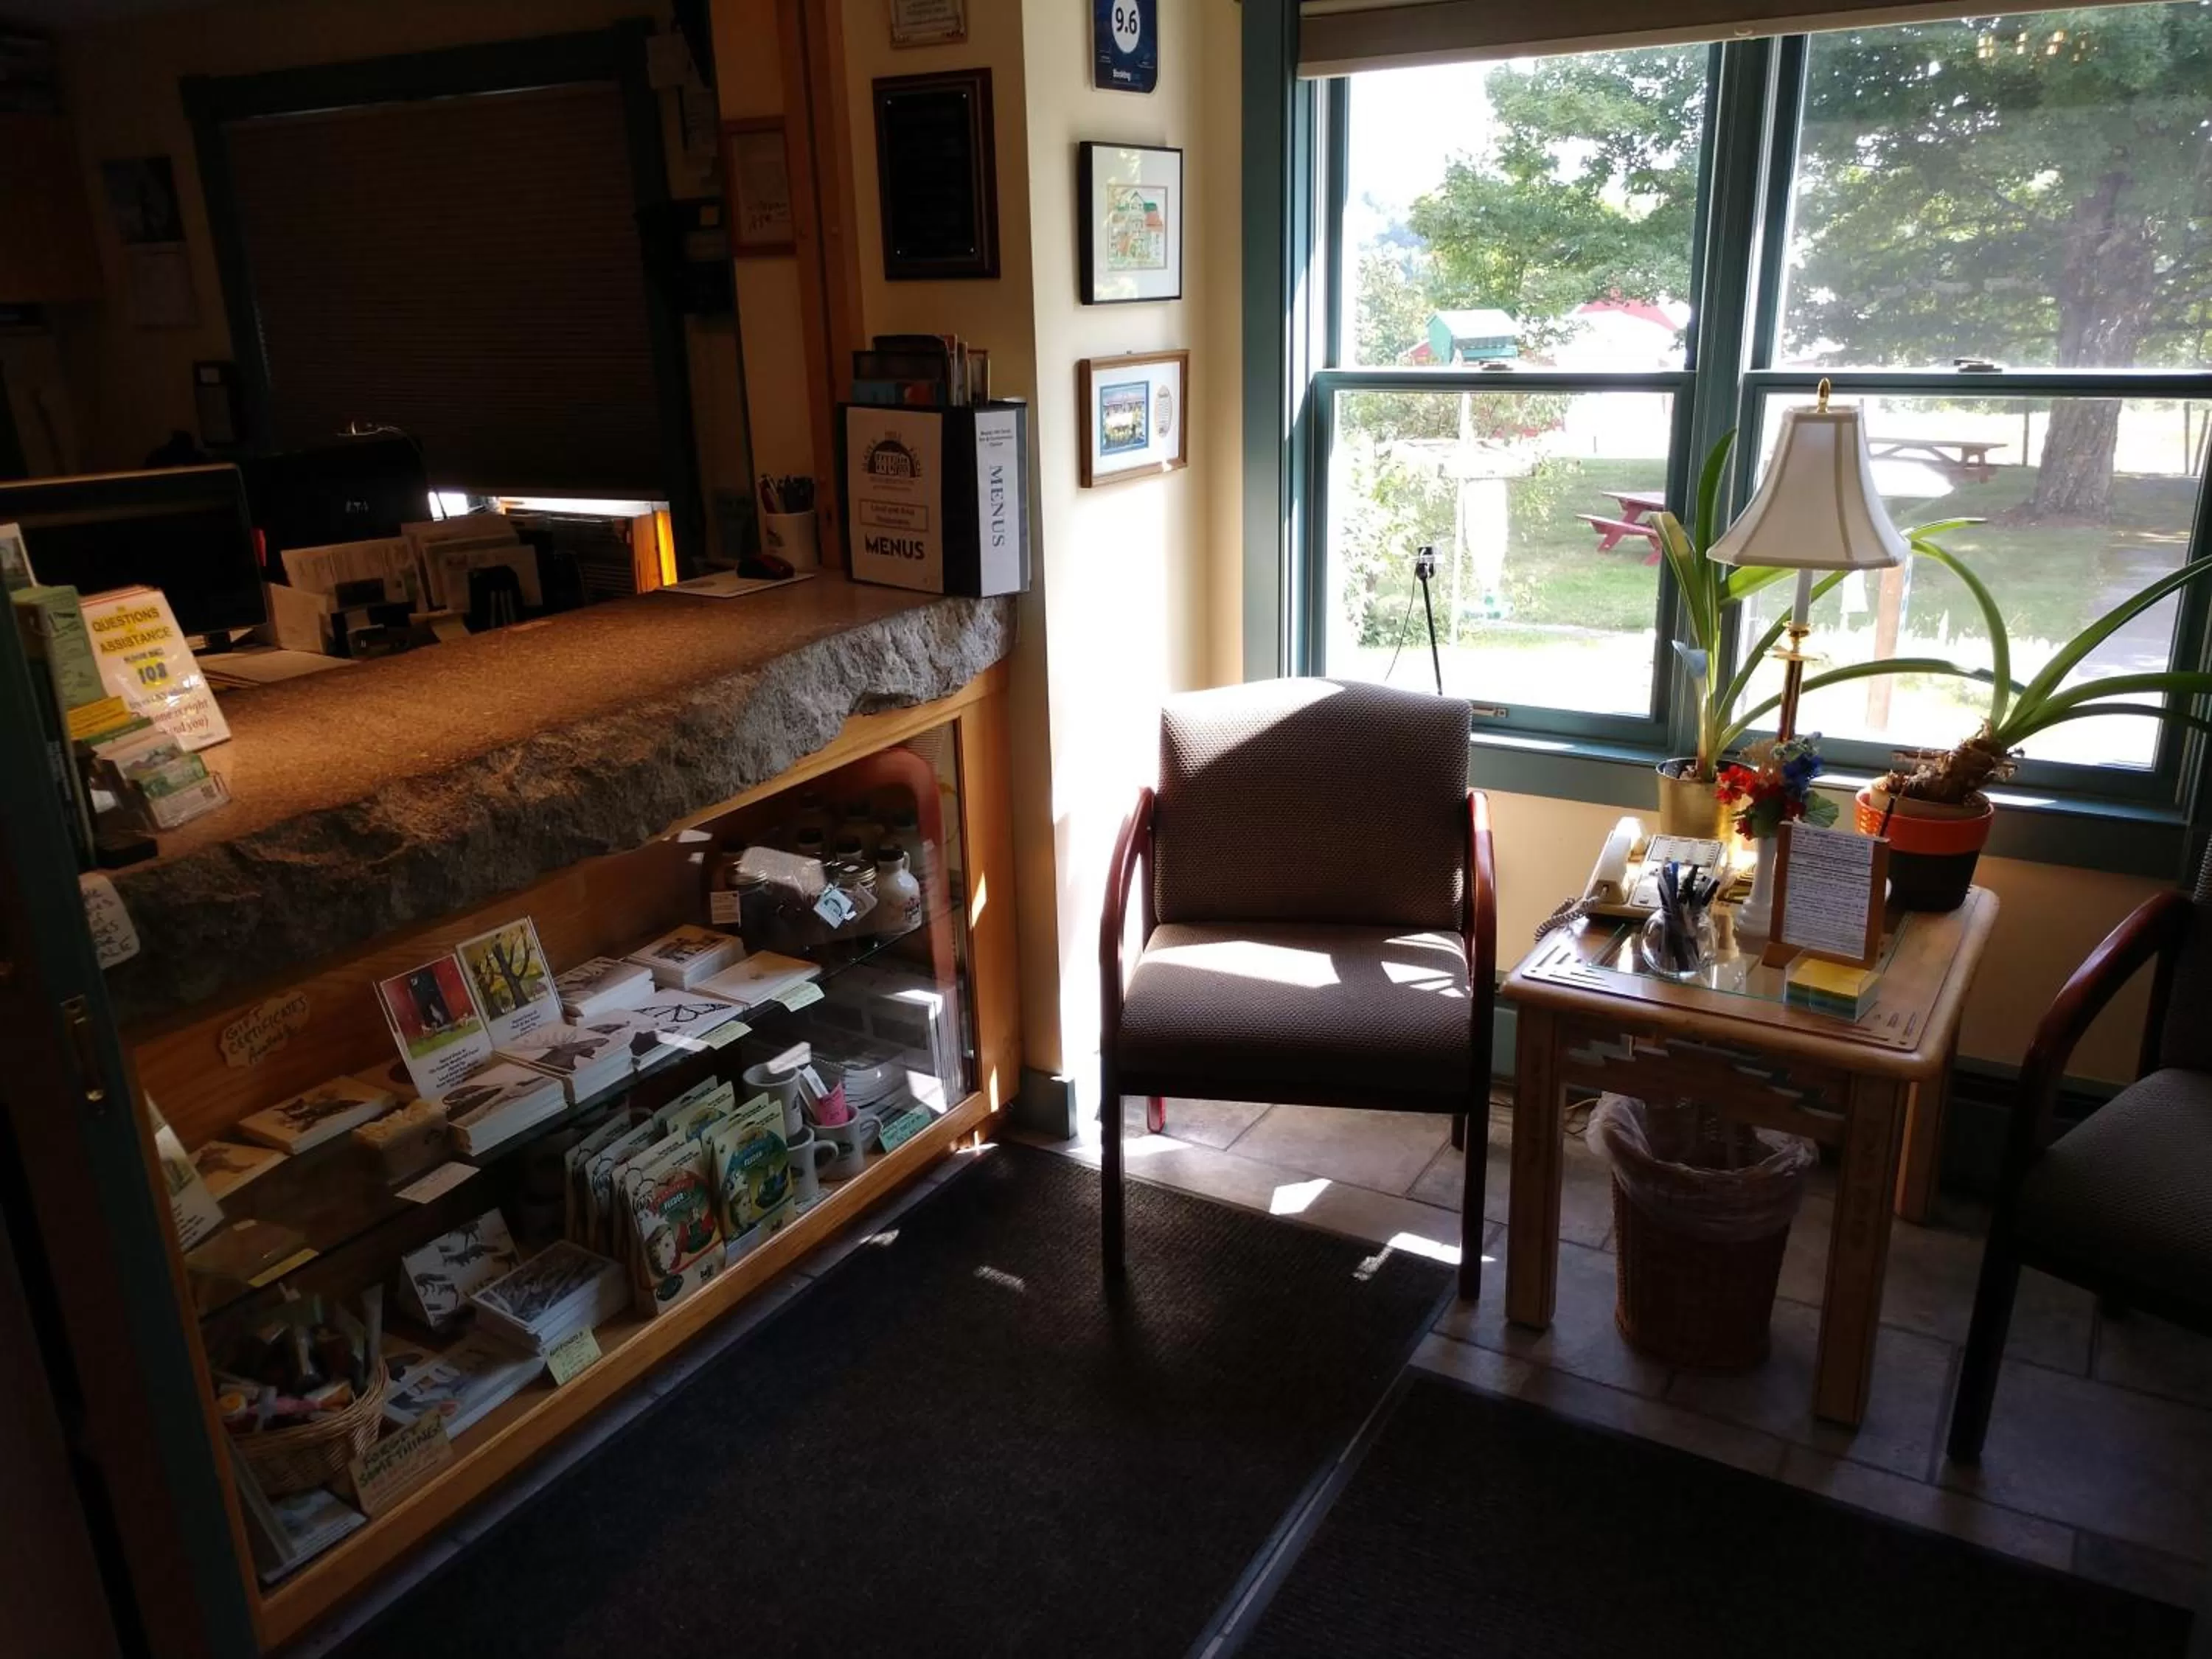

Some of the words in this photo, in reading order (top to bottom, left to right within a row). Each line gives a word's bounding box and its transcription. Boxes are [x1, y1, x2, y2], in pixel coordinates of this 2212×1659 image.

[1116, 7, 1138, 35] 9.6
[990, 465, 1005, 548] MENUS
[864, 532, 925, 560] MENUS
[91, 606, 161, 633] QUESTIONS
[100, 626, 174, 655] ASSISTANCE
[137, 661, 167, 685] 108
